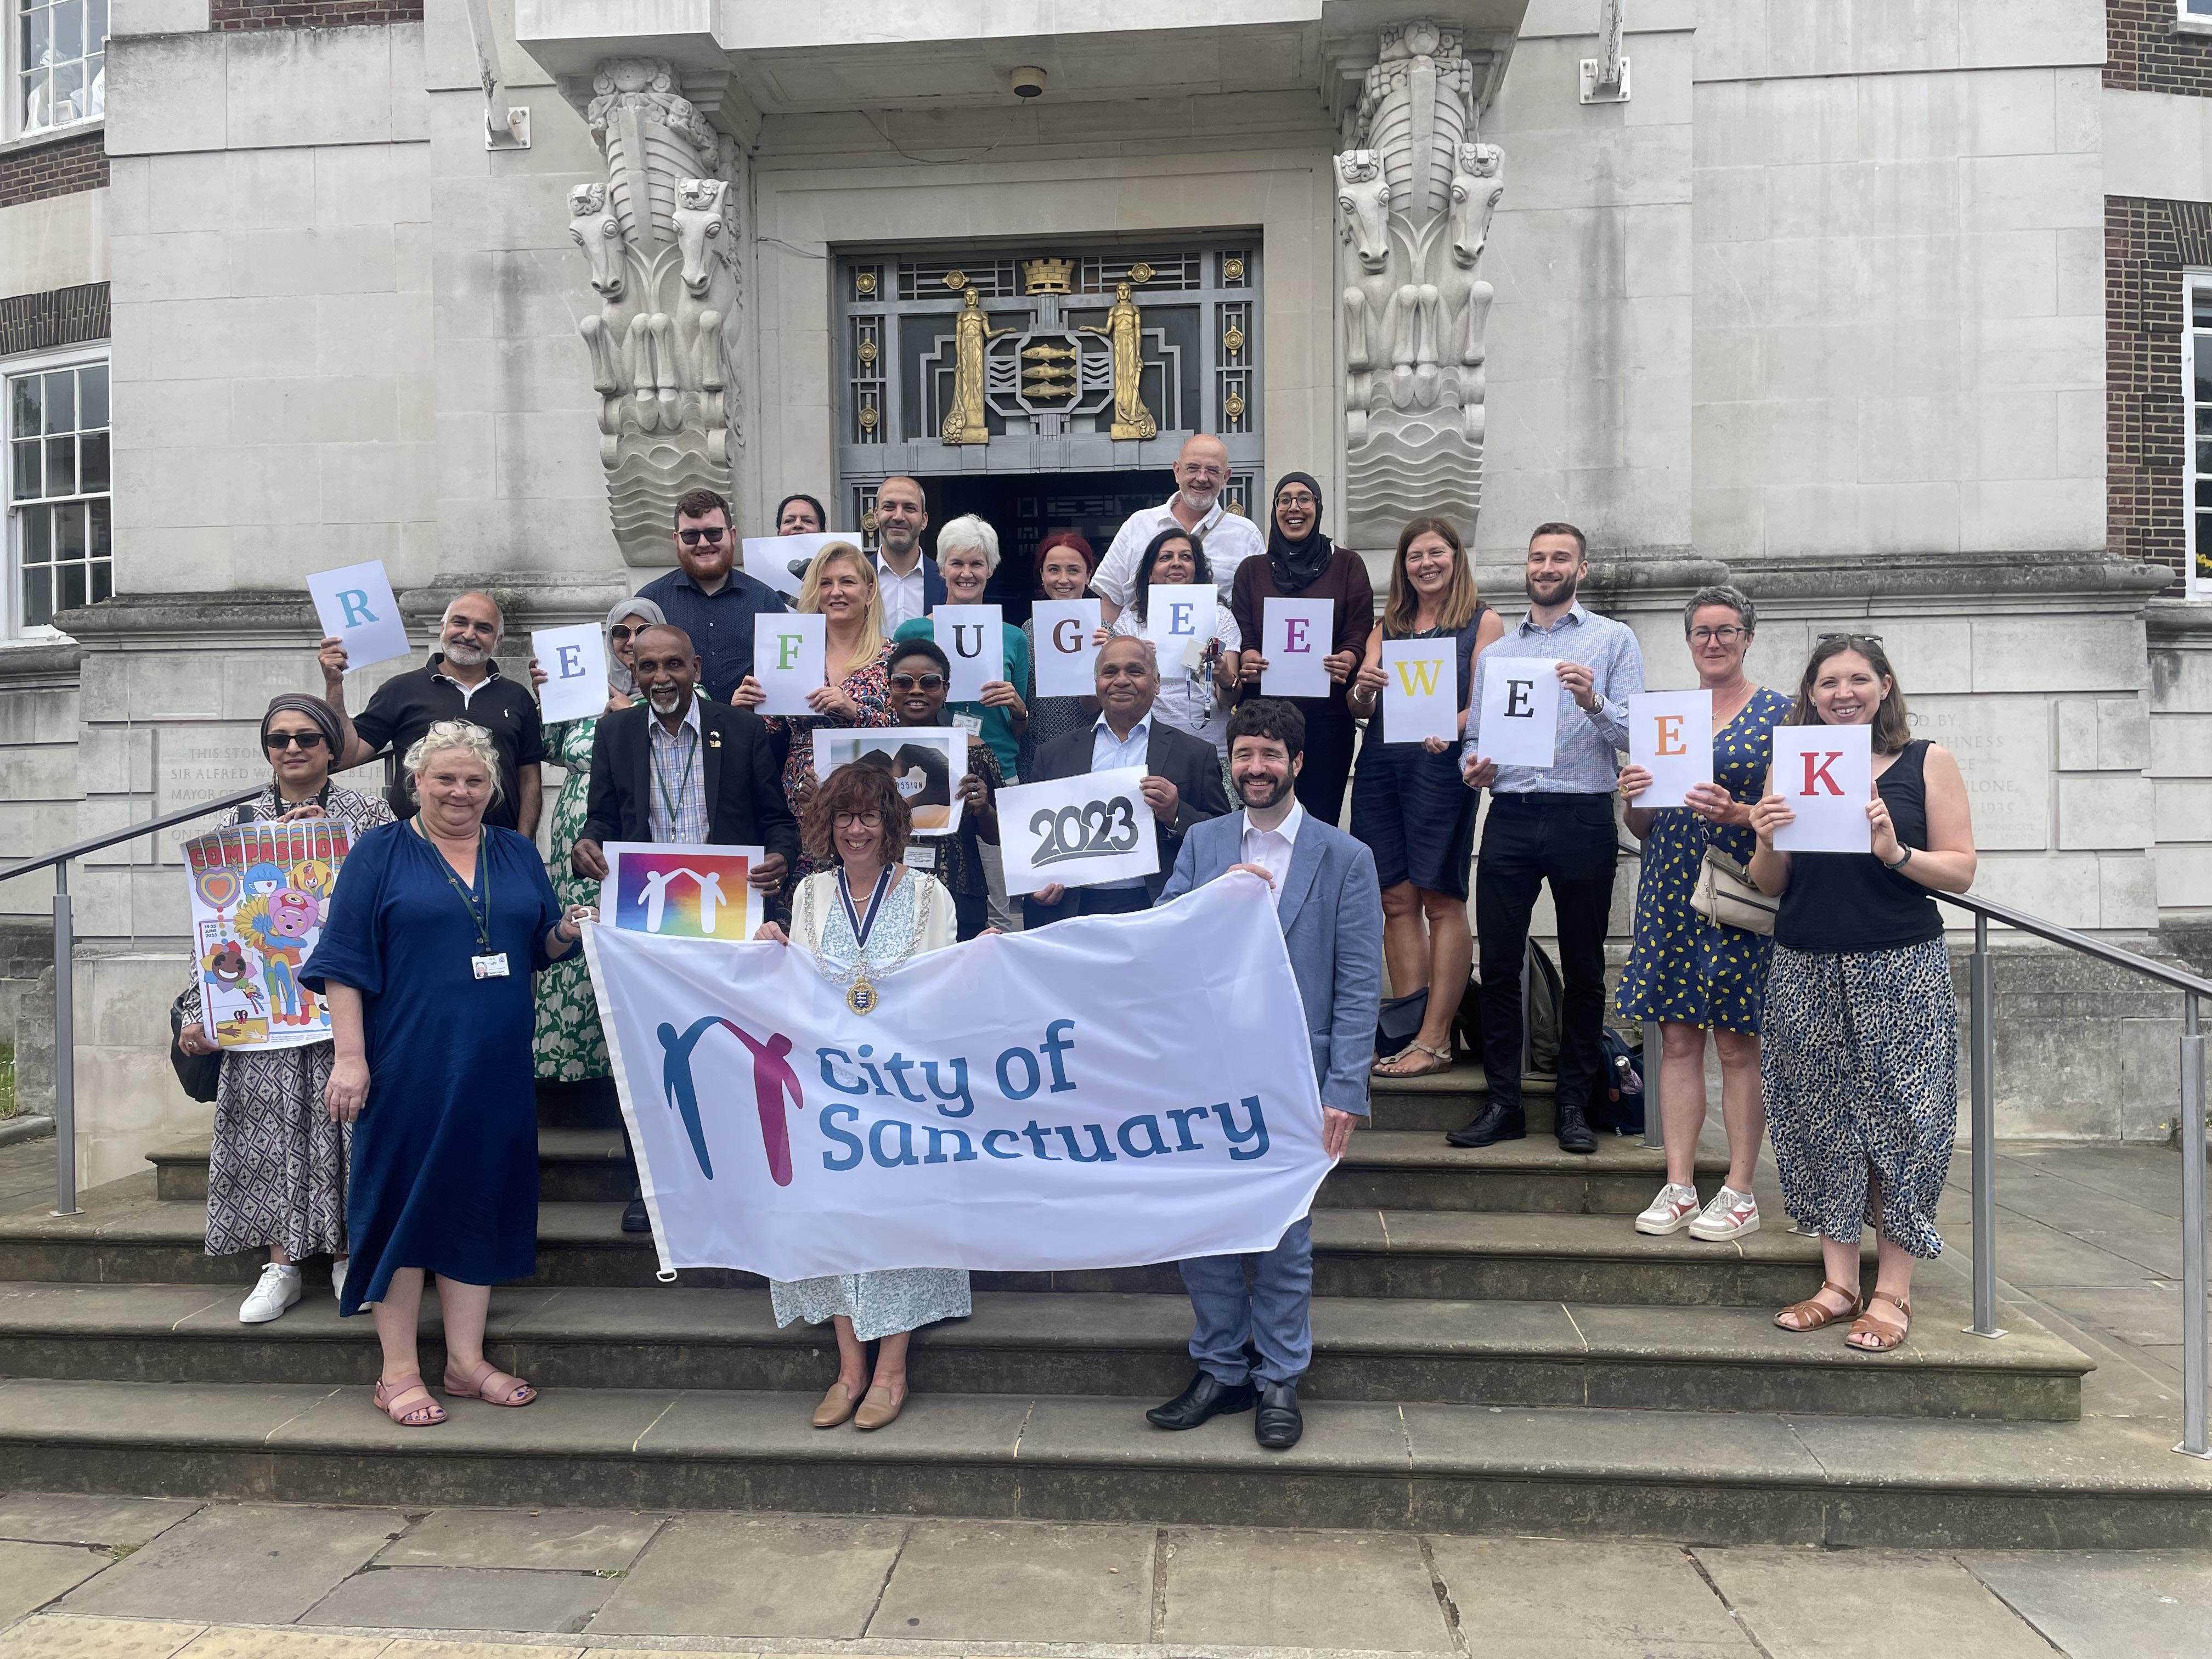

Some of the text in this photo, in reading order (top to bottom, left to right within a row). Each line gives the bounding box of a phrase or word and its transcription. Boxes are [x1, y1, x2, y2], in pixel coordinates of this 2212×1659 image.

[336, 590, 379, 628] R
[1169, 603, 1195, 635] E
[777, 635, 802, 669] F
[952, 625, 984, 658] U
[1053, 619, 1083, 653] G
[1284, 619, 1311, 653] E
[556, 645, 585, 679] E
[1395, 660, 1443, 696] W
[1504, 680, 1534, 718] E
[1654, 715, 1686, 755] E
[188, 747, 262, 759] THIS STON
[171, 769, 191, 779] SIR
[196, 768, 249, 779] ALFRED
[1799, 752, 1844, 795] K
[172, 789, 213, 800] MAYOR
[171, 830, 191, 840] ON
[186, 822, 350, 871] COMPASSION
[1029, 795, 1138, 866] 2023
[816, 1019, 1077, 1117] City of
[819, 1095, 1269, 1171] Sanctuary
